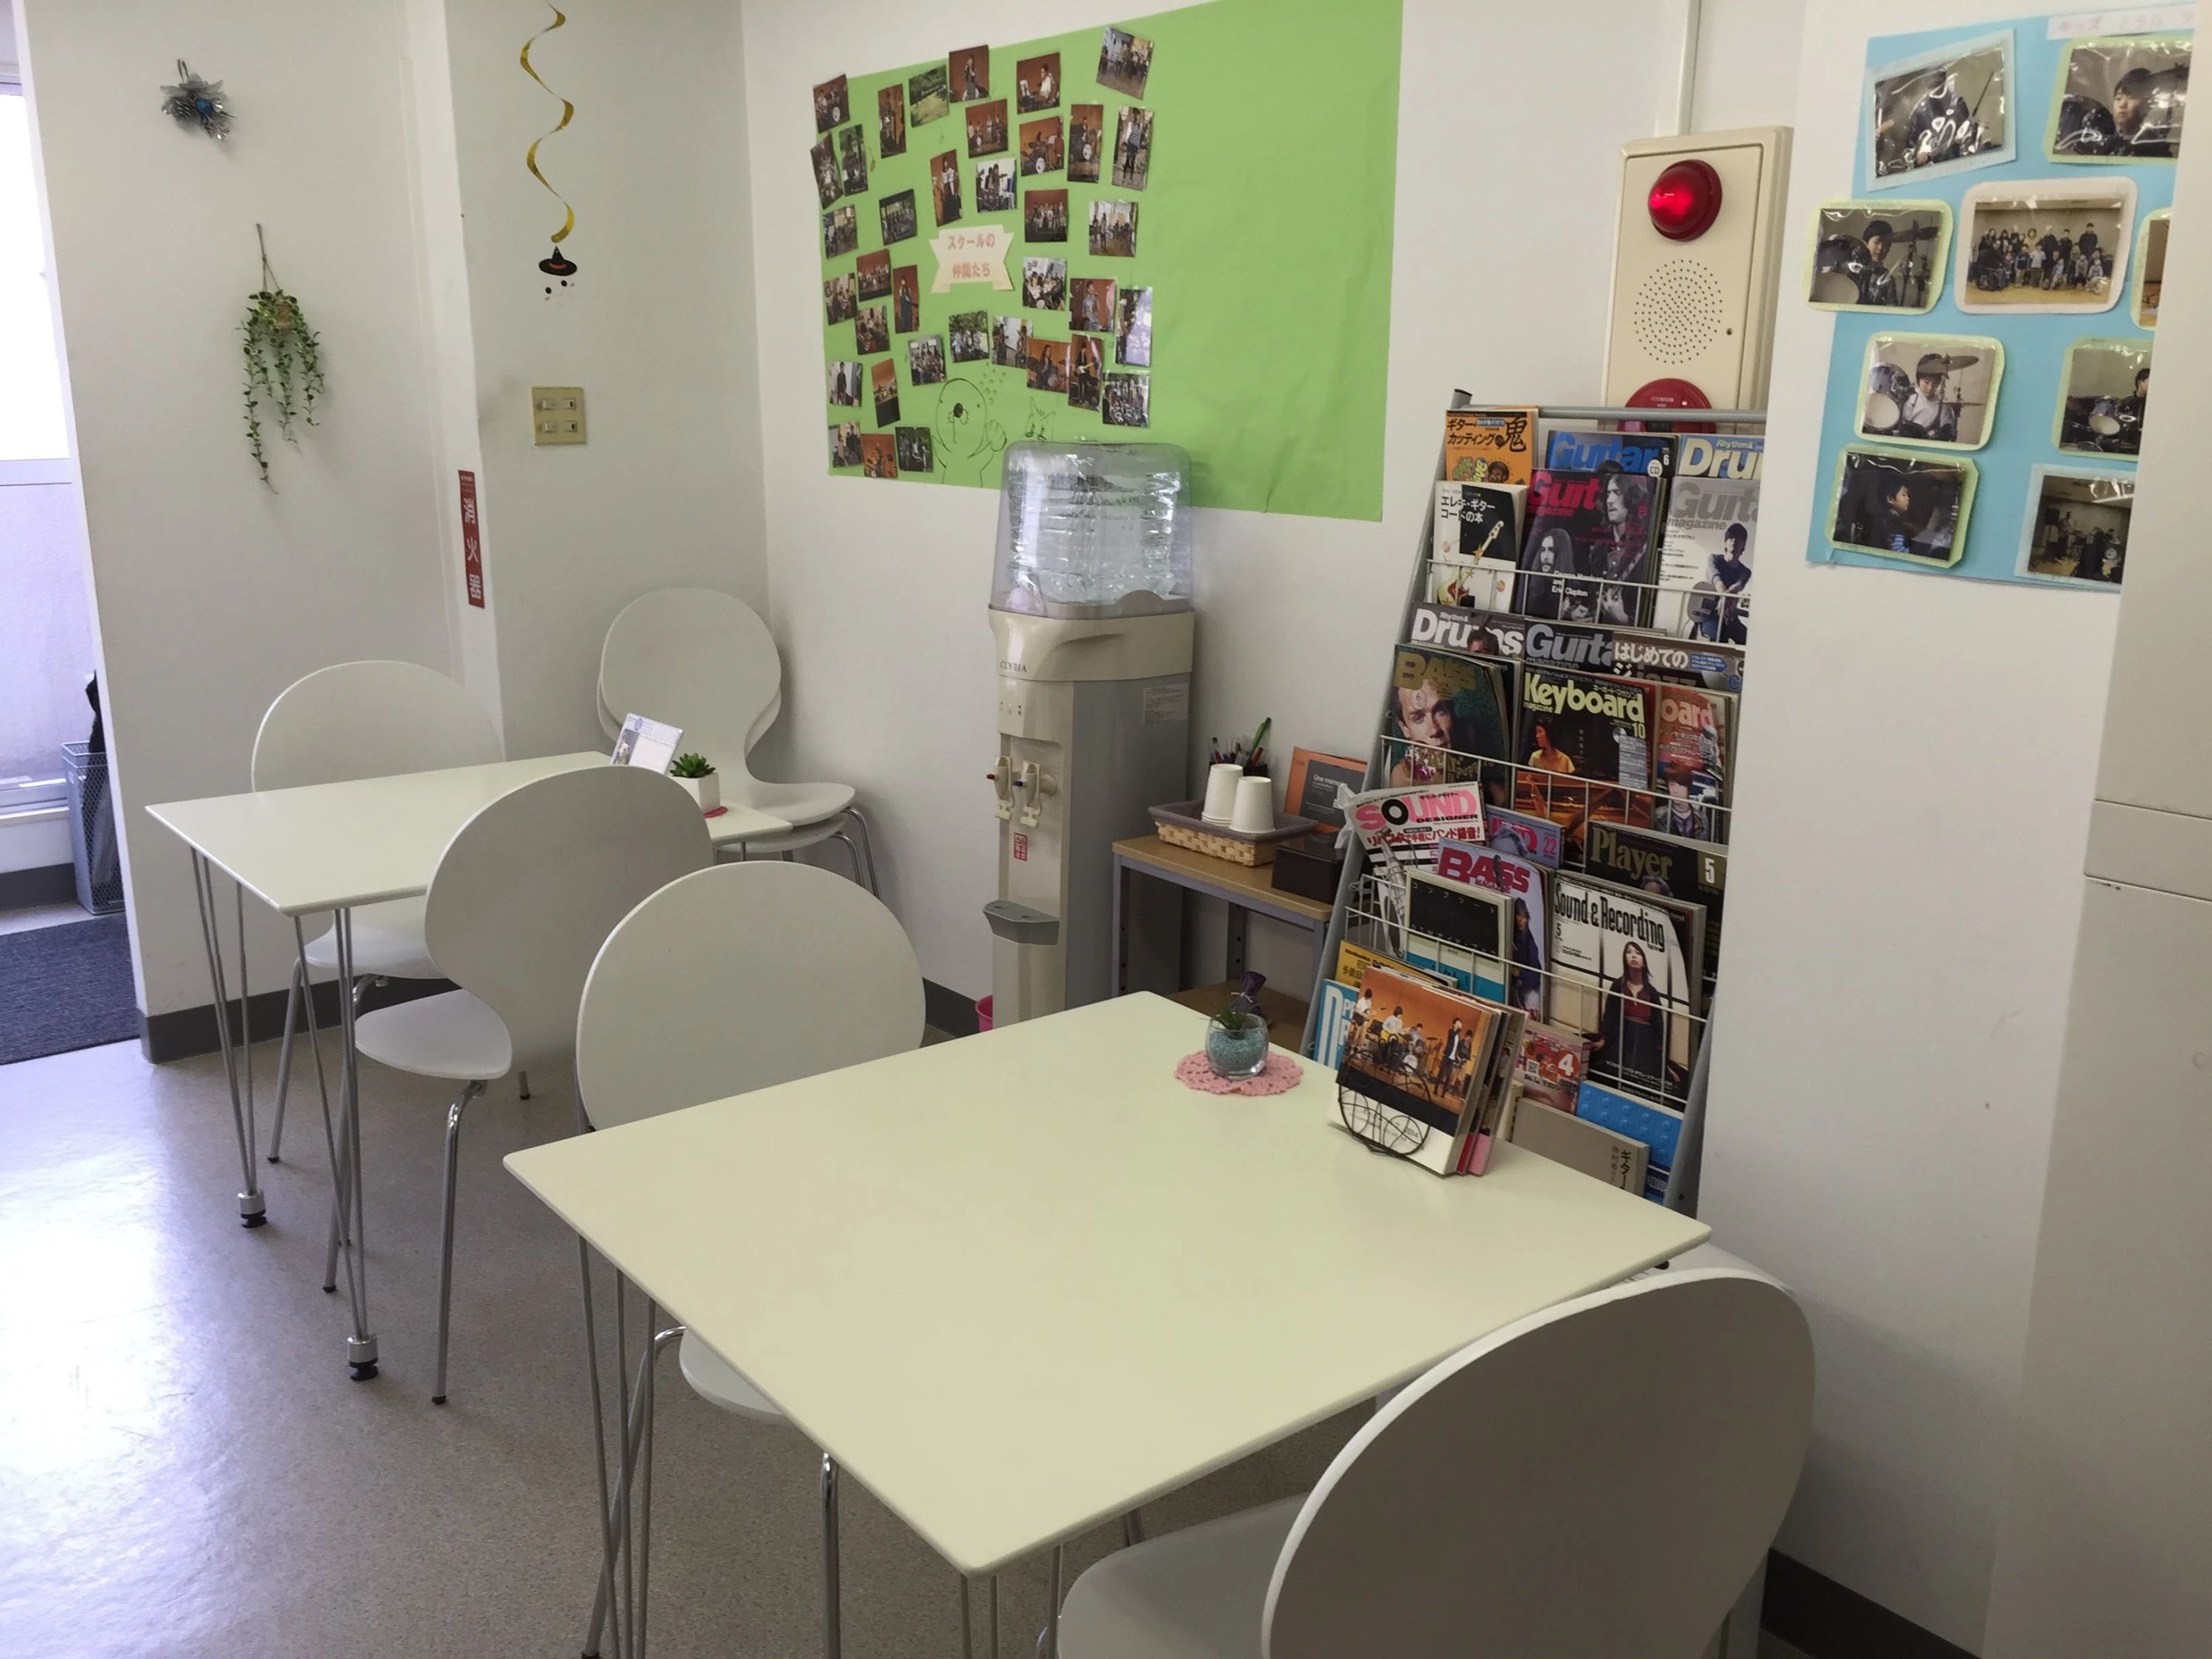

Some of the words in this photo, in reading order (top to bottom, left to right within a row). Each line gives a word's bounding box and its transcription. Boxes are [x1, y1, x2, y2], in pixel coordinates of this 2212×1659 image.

[947, 233, 995, 250] スクールの
[1671, 481, 1758, 522] Guit
[1440, 509, 1484, 524] コードの本
[1667, 518, 1727, 530] magazine
[1614, 641, 1689, 669] はじめての
[1523, 672, 1646, 723] Keyboard
[1632, 723, 1646, 740] 10
[1355, 789, 1478, 831] SOUND
[1416, 813, 1478, 824] DESIGNER
[1544, 835, 1558, 855] 22
[1590, 826, 1673, 880] Player
[1439, 846, 1531, 894] BASS
[1704, 857, 1716, 884] 5
[1554, 882, 1589, 925] Sound
[1599, 895, 1666, 953] Recording
[1557, 1053, 1574, 1077] 4
